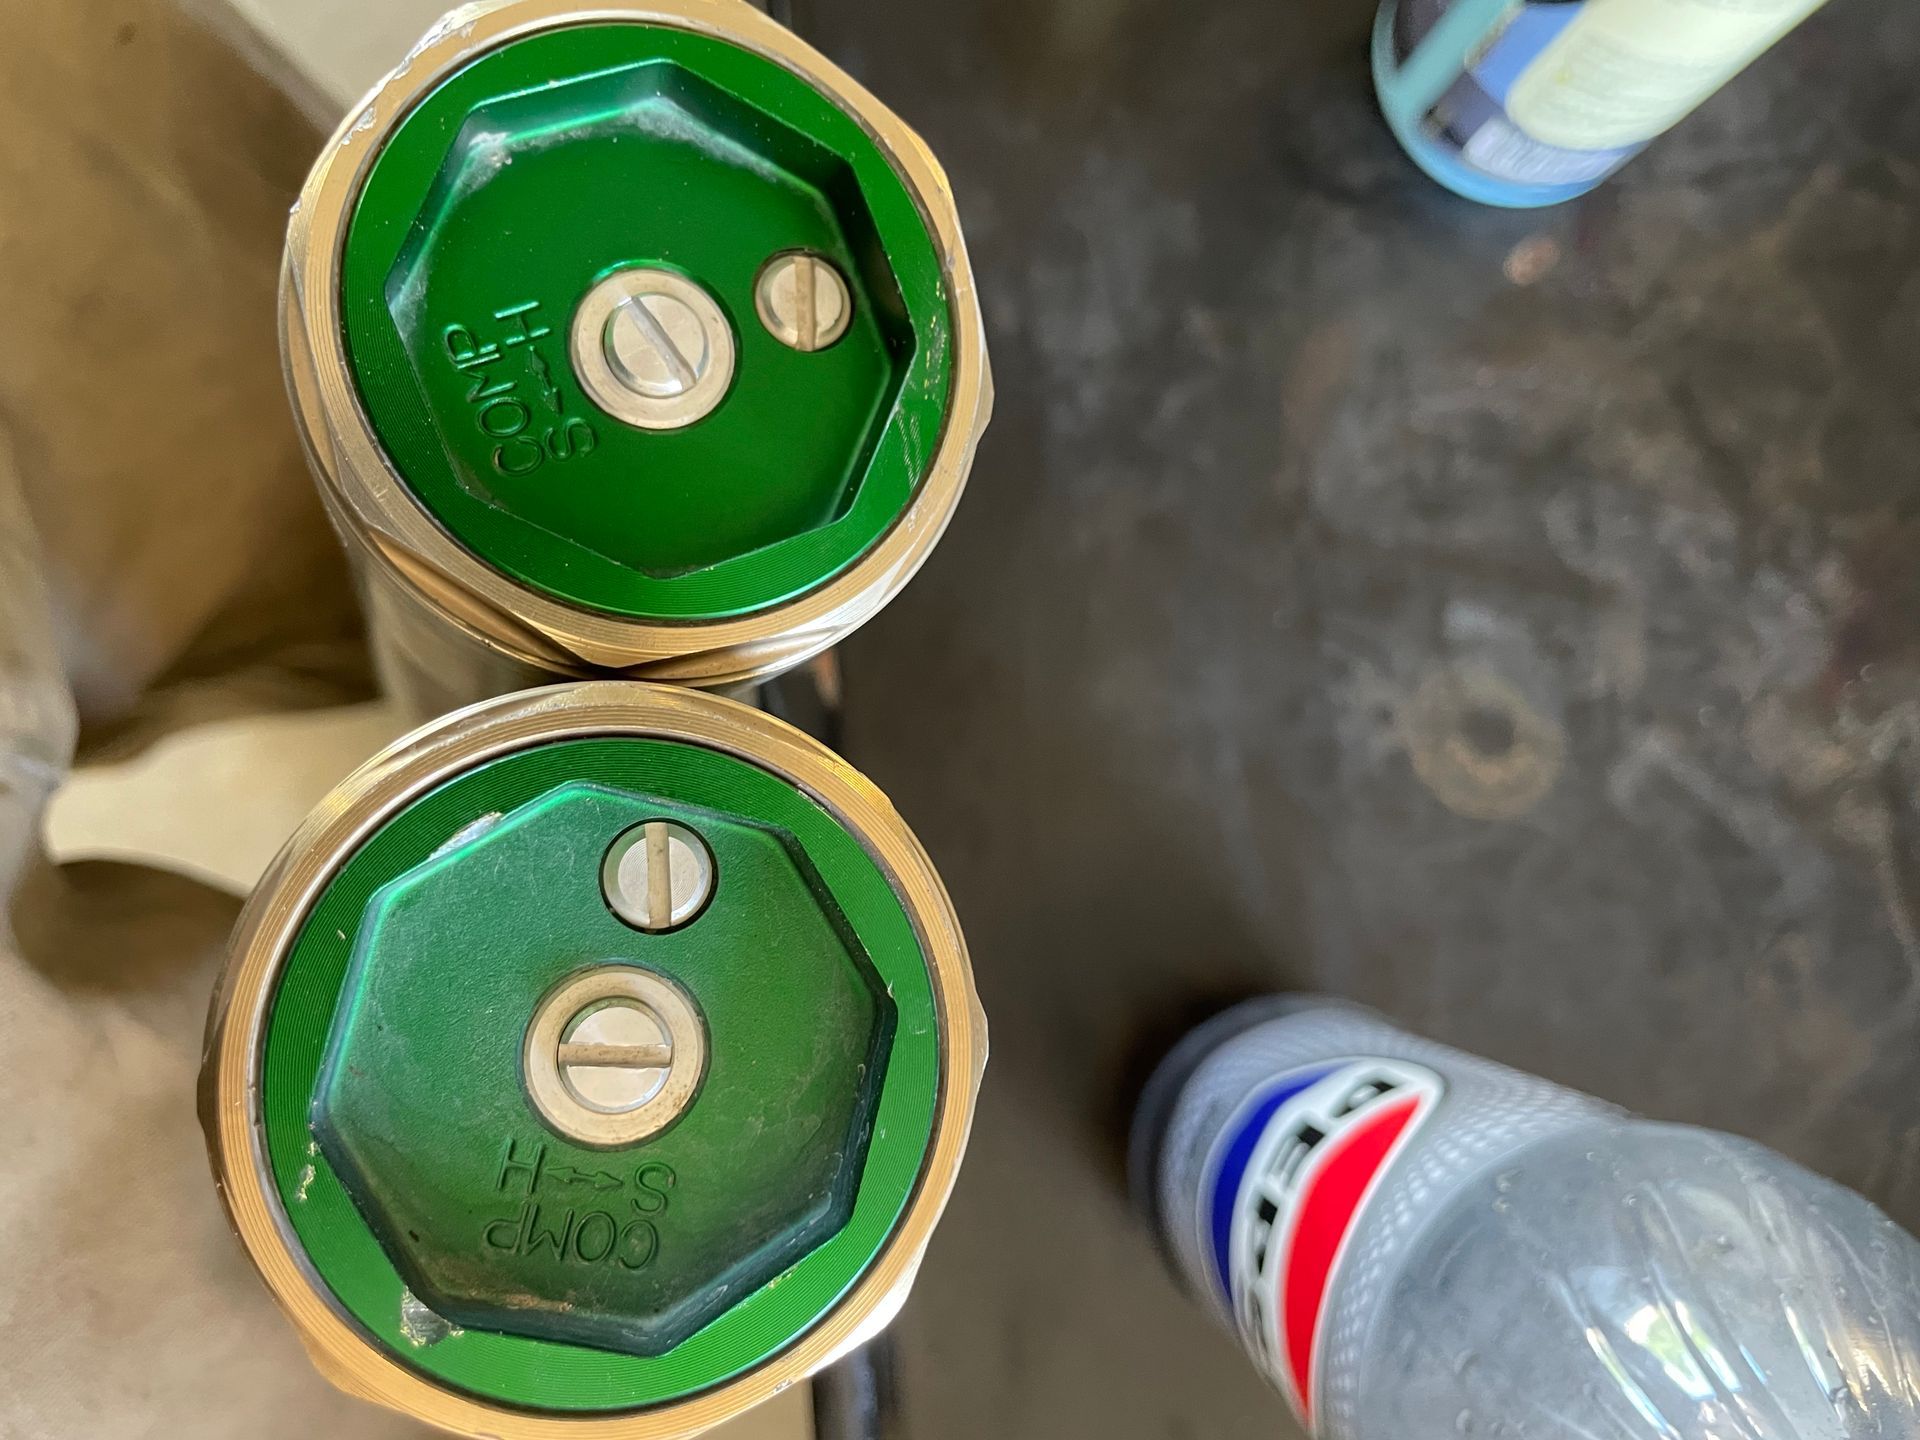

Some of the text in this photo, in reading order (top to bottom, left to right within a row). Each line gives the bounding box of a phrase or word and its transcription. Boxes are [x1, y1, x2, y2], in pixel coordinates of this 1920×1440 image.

[444, 323, 543, 475] COMP
[494, 300, 598, 458] S H
[497, 1136, 676, 1214] S H
[482, 1202, 657, 1270] COMP
